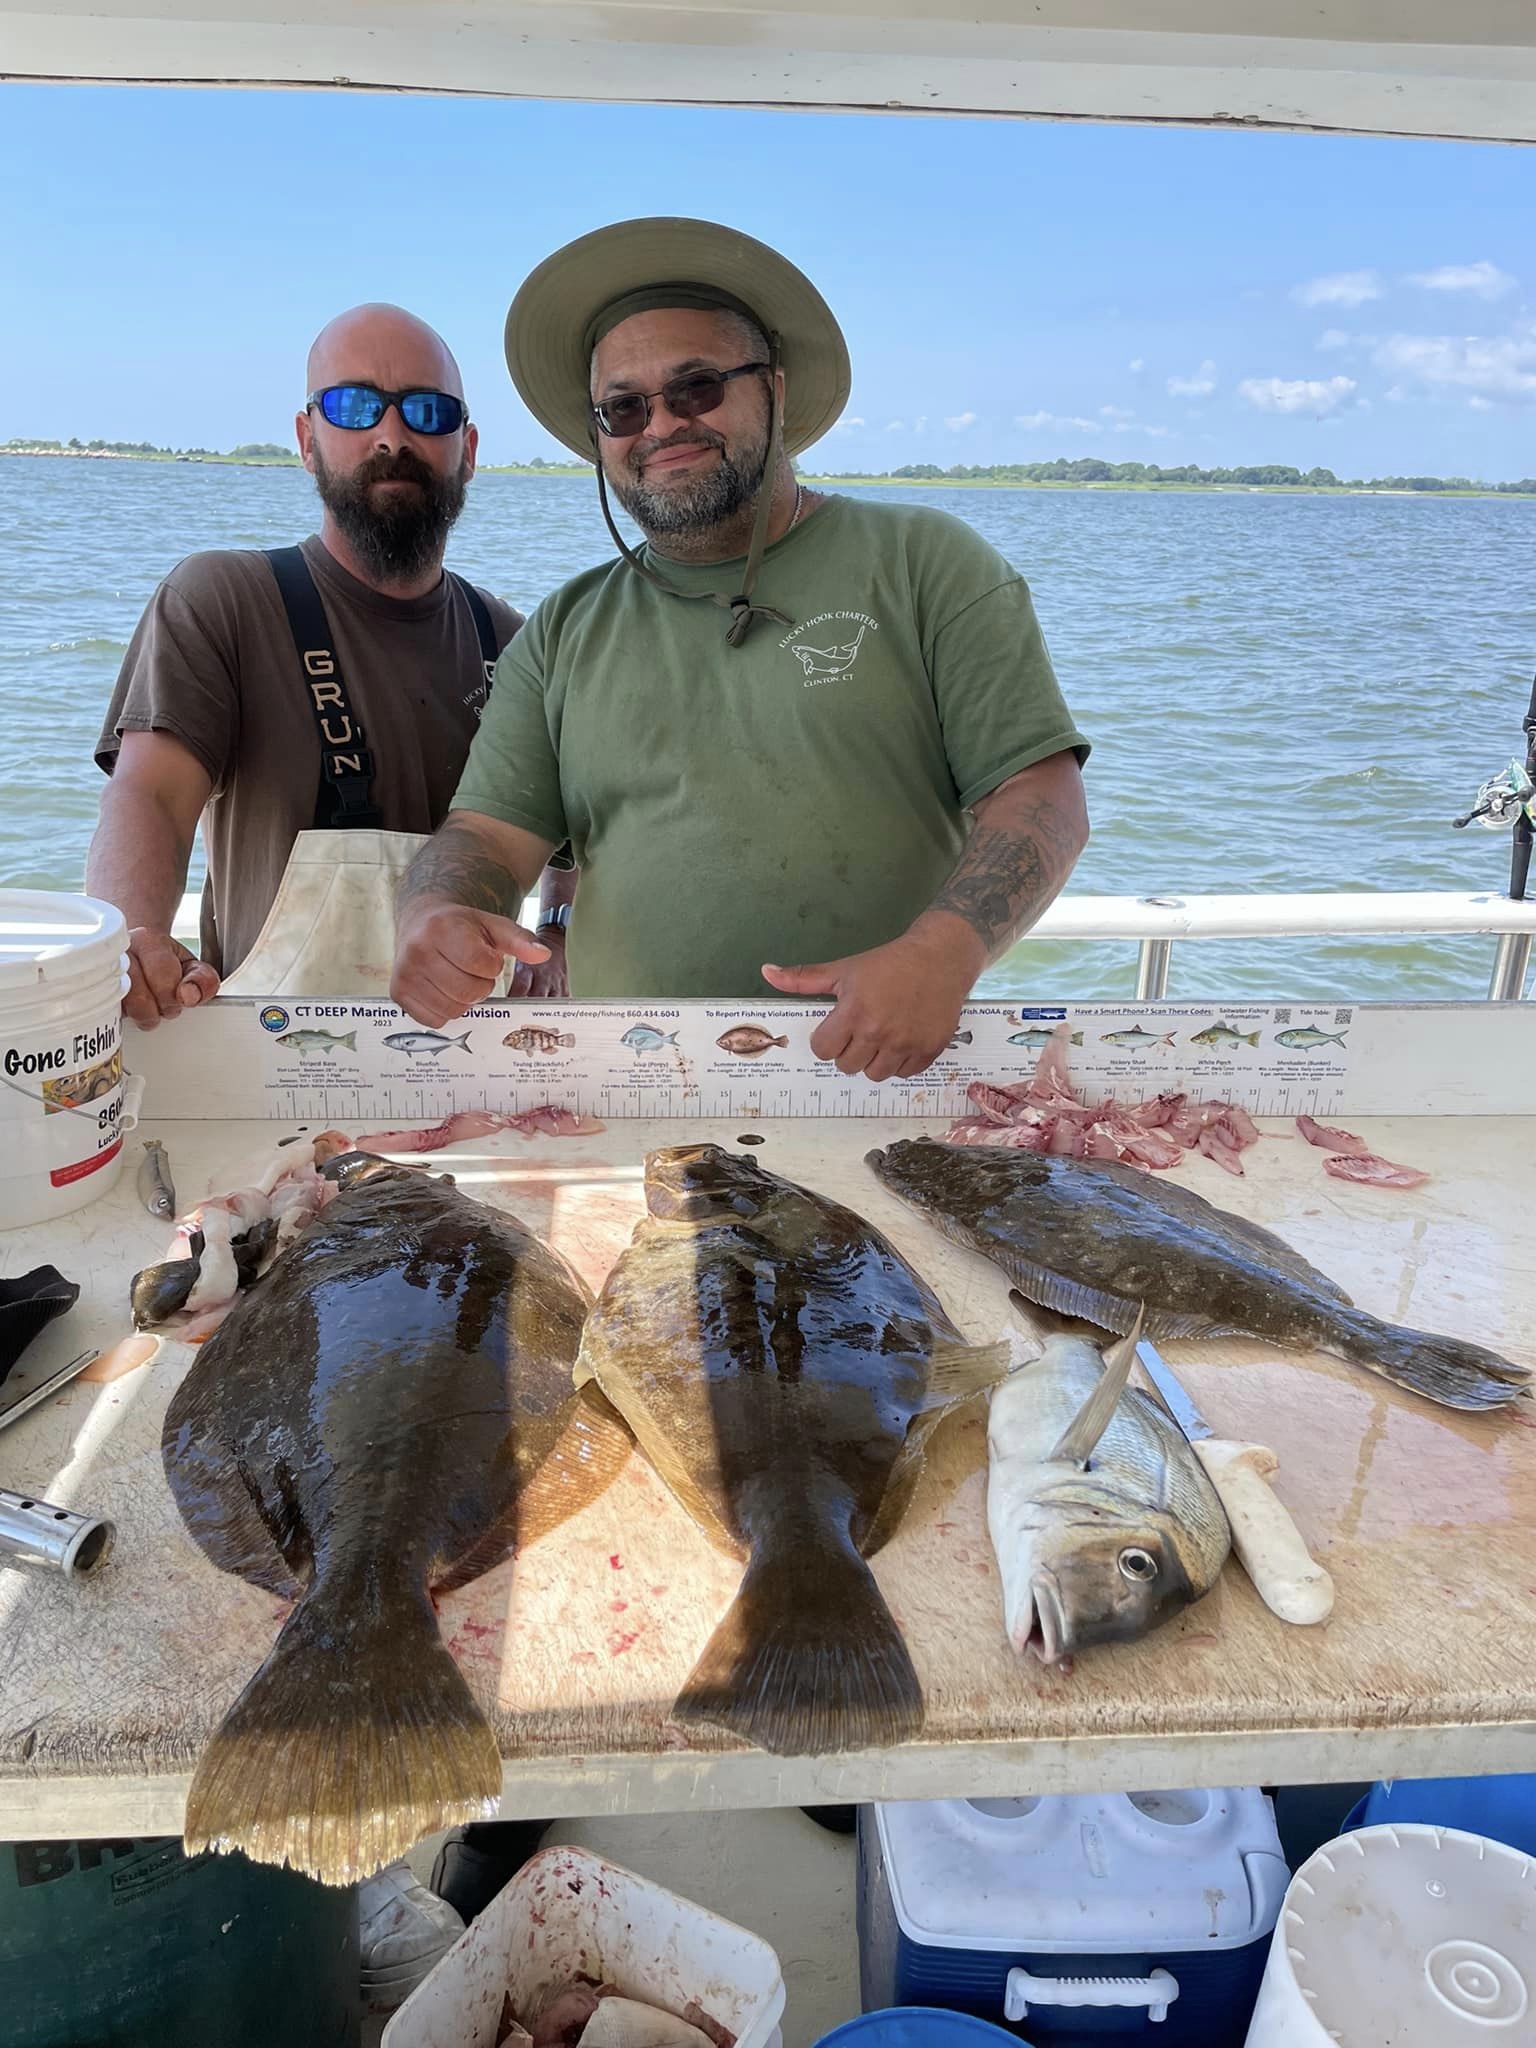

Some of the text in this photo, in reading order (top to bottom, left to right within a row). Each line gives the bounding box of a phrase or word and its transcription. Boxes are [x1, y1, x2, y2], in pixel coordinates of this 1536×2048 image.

[778, 610, 880, 649] LUCKY HOOK CHARTERS
[842, 673, 854, 681] CT
[295, 1007, 310, 1017] CT
[315, 1007, 348, 1017] DEEP
[352, 1007, 398, 1017] Marine
[532, 1009, 625, 1018] www.ct.gov/deep/fishing
[715, 1010, 740, 1019] Report
[741, 1010, 767, 1018] Fishing
[1075, 1008, 1092, 1016] Have
[1100, 1008, 1120, 1016] Smart
[1122, 1008, 1149, 1016] Phone?
[1150, 1008, 1166, 1016] Scan
[1168, 1008, 1190, 1016] These
[1191, 1008, 1213, 1016] Codes:
[4, 1017, 118, 1076] Gone Fishin'
